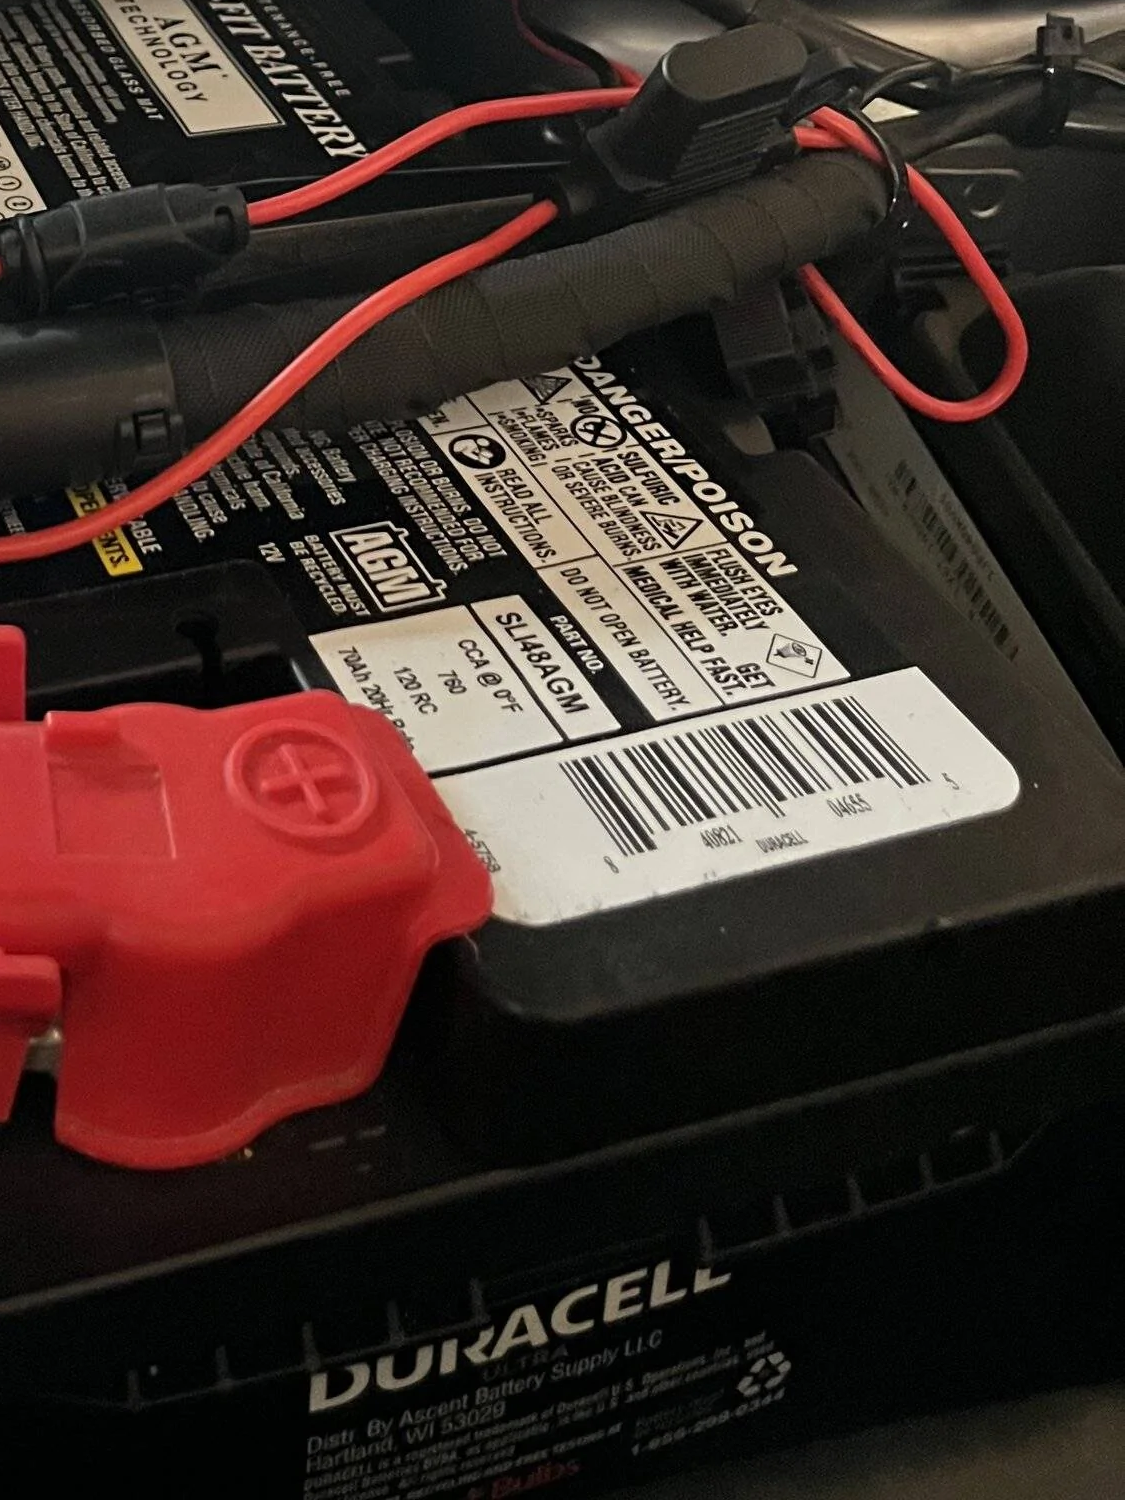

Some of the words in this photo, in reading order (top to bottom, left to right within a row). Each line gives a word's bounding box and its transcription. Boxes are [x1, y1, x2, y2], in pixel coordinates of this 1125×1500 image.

[108, 56, 144, 96] GLASS
[135, 98, 165, 121] MAT
[243, 45, 370, 157] BATTERY
[574, 398, 599, 415] NO
[262, 470, 305, 520] California
[295, 447, 347, 506] accessories
[322, 448, 357, 483] Battery
[419, 460, 443, 476] OR
[496, 467, 534, 500] READ
[525, 501, 553, 524] ALL
[574, 355, 798, 577] DANGER/POISON
[591, 457, 630, 484] ACID
[618, 486, 650, 507] CAN
[617, 452, 679, 505] SULFURIC
[198, 493, 228, 525] cause
[359, 442, 410, 495] CHARGING
[398, 495, 469, 576] INSTRUCTIONS.
[377, 437, 407, 457] NOT
[394, 458, 467, 538] RECOMMENDED
[455, 538, 485, 562] FOR
[463, 517, 488, 534] DO
[474, 472, 557, 563] INSTRUCTIONS.
[551, 466, 572, 482] OR
[565, 480, 611, 520] SEVERE
[598, 519, 642, 562] BURNS.
[572, 462, 613, 493] CAUSE
[602, 492, 662, 552] BLINDNESS
[258, 542, 286, 564] 12V
[289, 541, 310, 556] BE
[304, 534, 347, 582] BATTERY
[337, 583, 372, 616] MUST
[341, 531, 431, 604] AGM
[475, 534, 508, 557] NOT
[659, 557, 700, 590] WITH
[687, 590, 739, 637] WATER.
[681, 552, 771, 631] IMMEDIATELY
[704, 548, 755, 585] FLUSH
[742, 584, 784, 617] EYES
[457, 639, 490, 670] CCA
[549, 614, 587, 650] PART
[578, 653, 604, 675] NO.
[560, 566, 589, 586] DO
[575, 586, 612, 613] NOT
[599, 613, 643, 648] OPEN
[628, 648, 694, 711] BATTERY.
[623, 565, 681, 622] MEDICAL
[671, 620, 715, 655] HELP
[700, 656, 747, 697] FAST.
[338, 646, 372, 683] 70Ah
[393, 666, 422, 691] 120
[410, 693, 438, 715] RC
[437, 670, 467, 694] 760
[495, 611, 591, 714] SLI48AGM
[737, 662, 776, 690] GET
[603, 855, 620, 874] 8
[699, 824, 744, 850] 40821
[941, 772, 960, 790] 5
[309, 1259, 733, 1414] DURACELL
[366, 1417, 394, 1438] By
[399, 1393, 469, 1427] Ascent
[475, 1371, 545, 1405] Battery
[551, 1344, 619, 1382] Supply
[405, 1421, 434, 1444] WI
